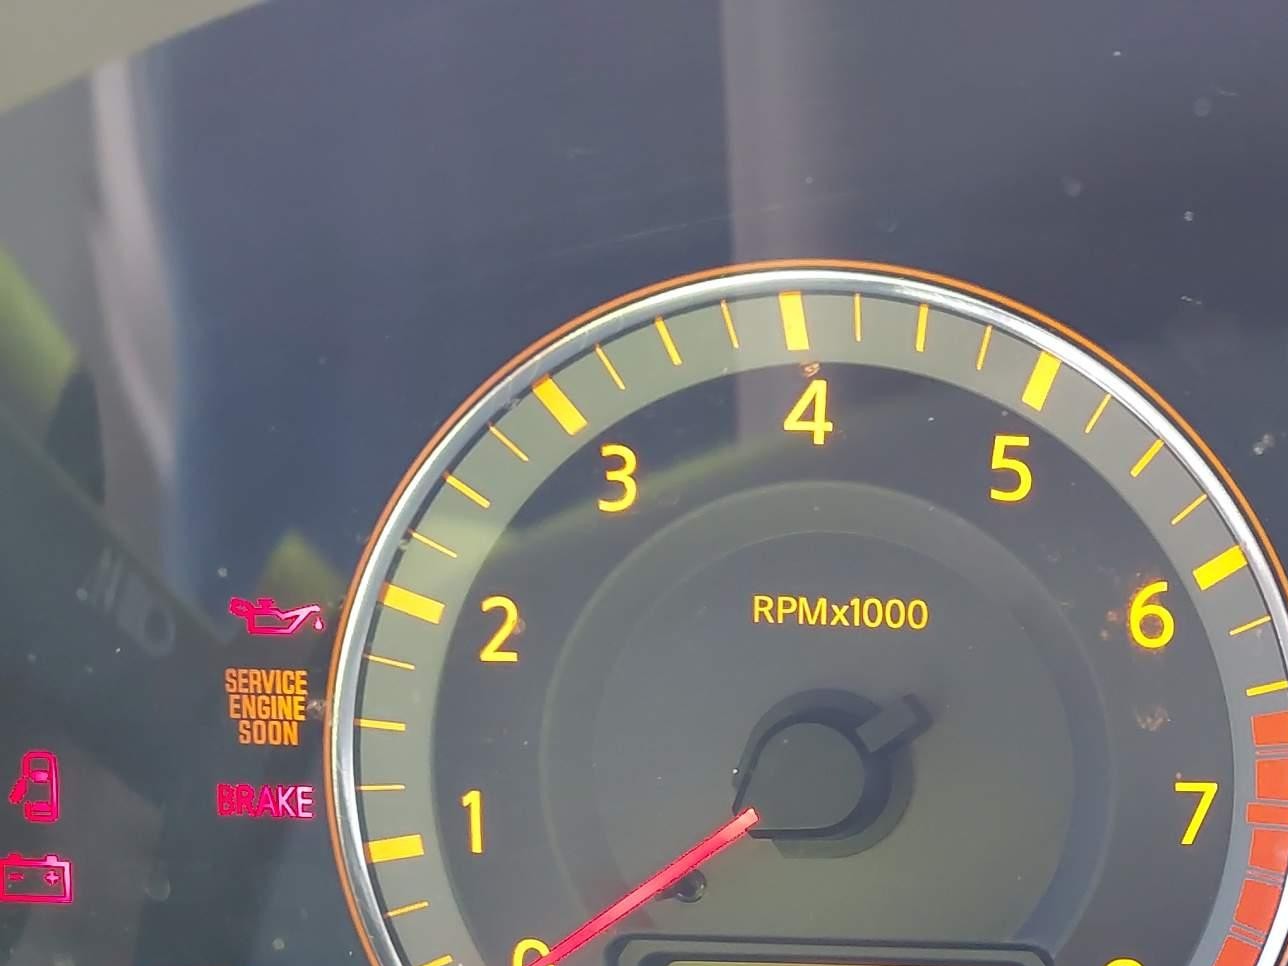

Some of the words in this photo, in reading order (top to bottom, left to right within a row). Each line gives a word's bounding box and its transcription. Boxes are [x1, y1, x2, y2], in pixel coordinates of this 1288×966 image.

[783, 379, 834, 446] 4
[598, 444, 639, 512] 3
[989, 434, 1034, 502] 5
[479, 596, 519, 663] 2
[752, 595, 929, 630] RPMx1000
[1129, 580, 1175, 650] 6
[224, 669, 308, 695] SERVICE
[229, 695, 306, 721] ENGINE
[238, 720, 299, 746] SOON
[216, 784, 315, 819] BRAKE
[461, 789, 485, 855] 1
[1174, 781, 1219, 845] 7
